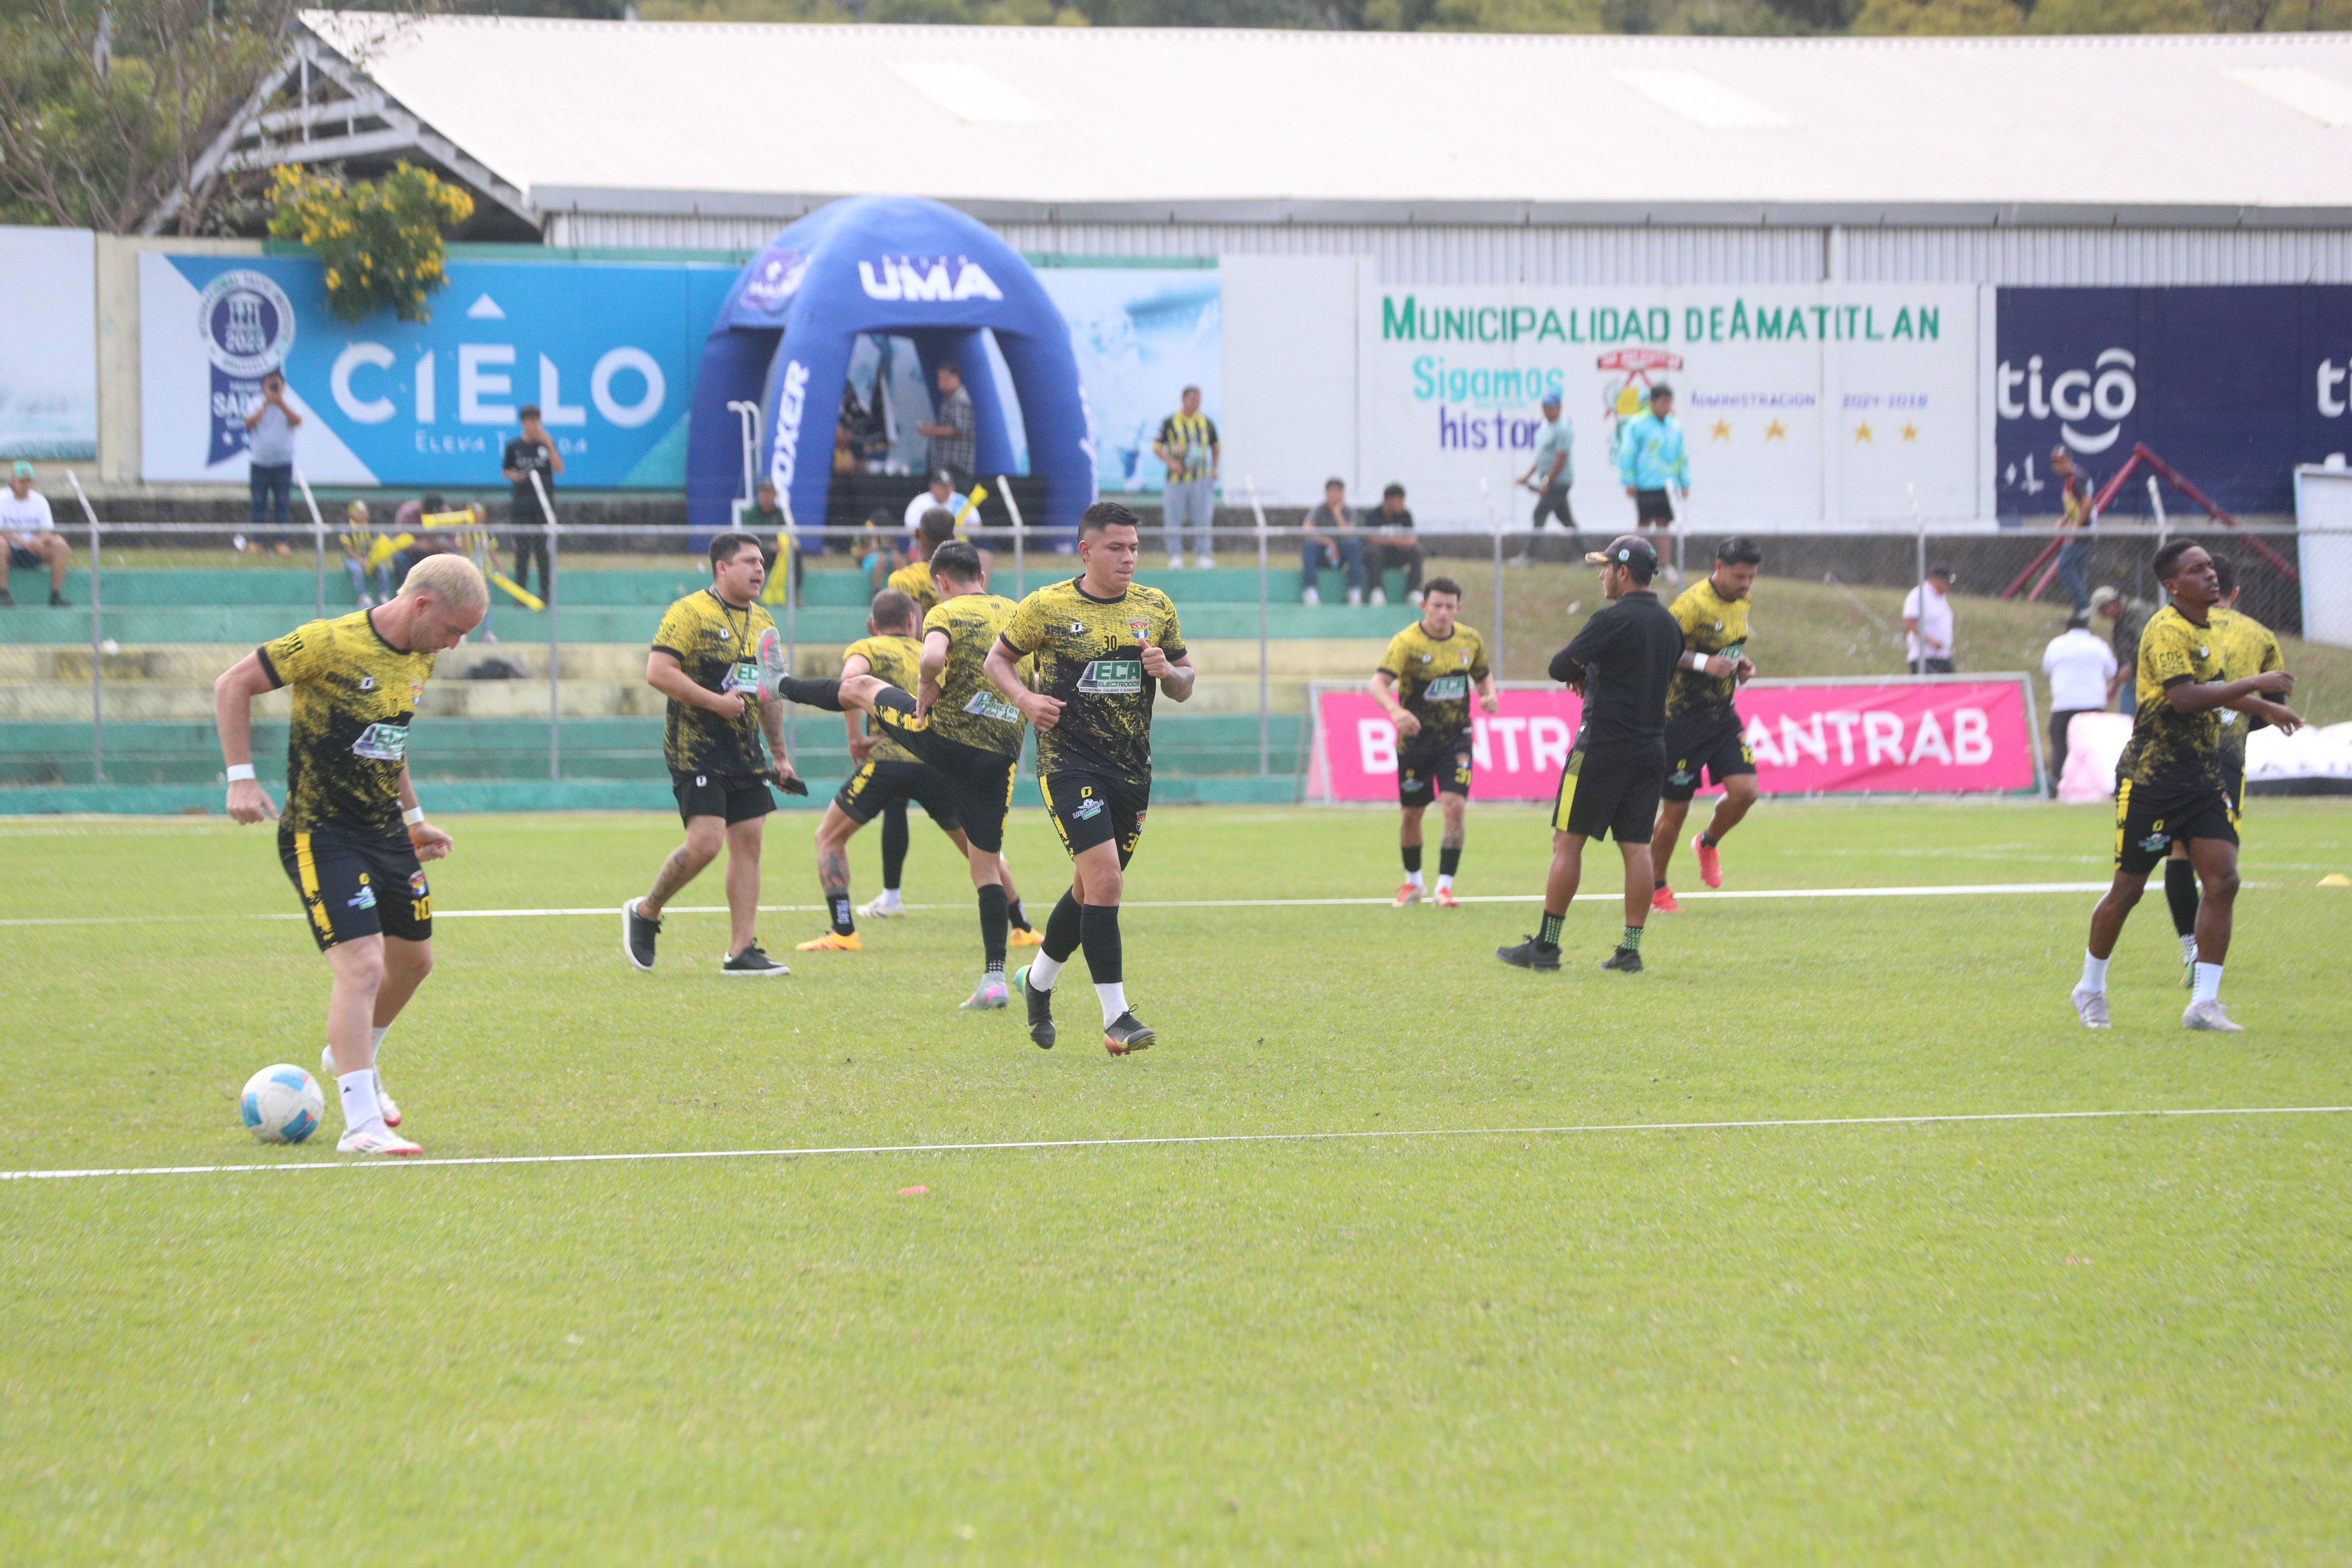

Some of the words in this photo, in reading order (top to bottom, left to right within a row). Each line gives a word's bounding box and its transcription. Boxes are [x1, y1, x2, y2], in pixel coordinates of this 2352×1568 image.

[858, 260, 1004, 301] UMA
[1383, 295, 1669, 343] MUNICIPALIDAD
[330, 342, 666, 428] CIELO
[1412, 354, 1565, 402] Sigamos
[1997, 347, 2136, 454] tigo
[1103, 635, 1117, 652] 30
[737, 667, 759, 680] EC
[1096, 662, 1140, 680] ECA
[1746, 708, 1993, 767] ANTRAB
[410, 895, 431, 921] 10
